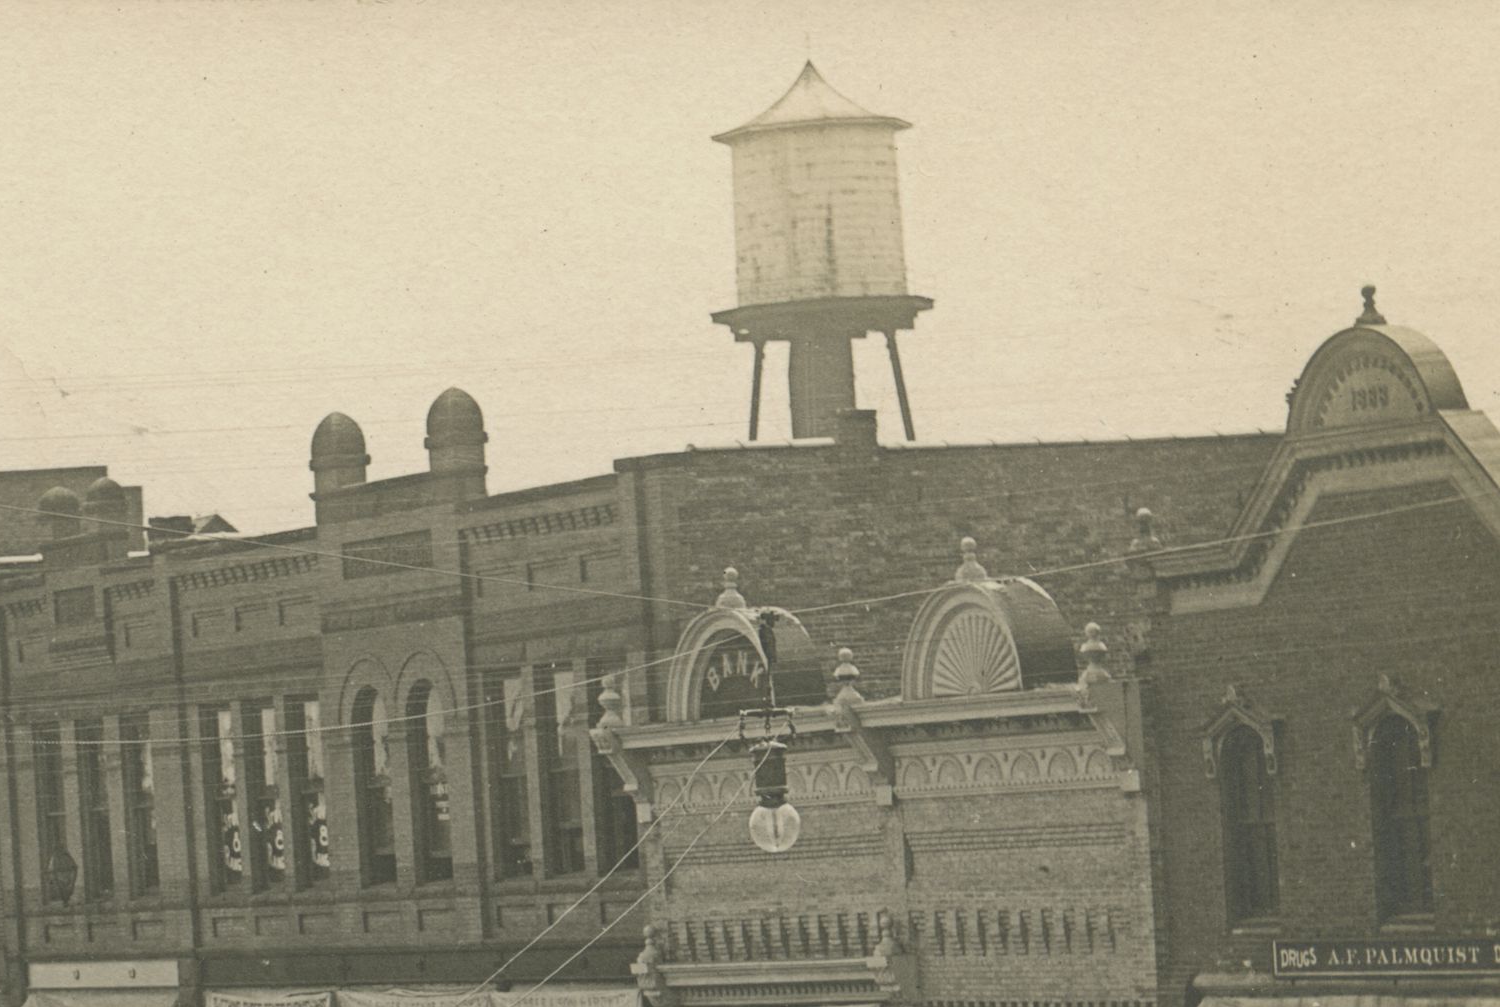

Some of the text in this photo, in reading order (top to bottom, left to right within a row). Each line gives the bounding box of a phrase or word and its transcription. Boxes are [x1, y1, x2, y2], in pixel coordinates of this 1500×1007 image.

[707, 650, 764, 691] BANK
[1280, 946, 1317, 969] DRUGS
[1365, 945, 1481, 966] PALMQUIST
